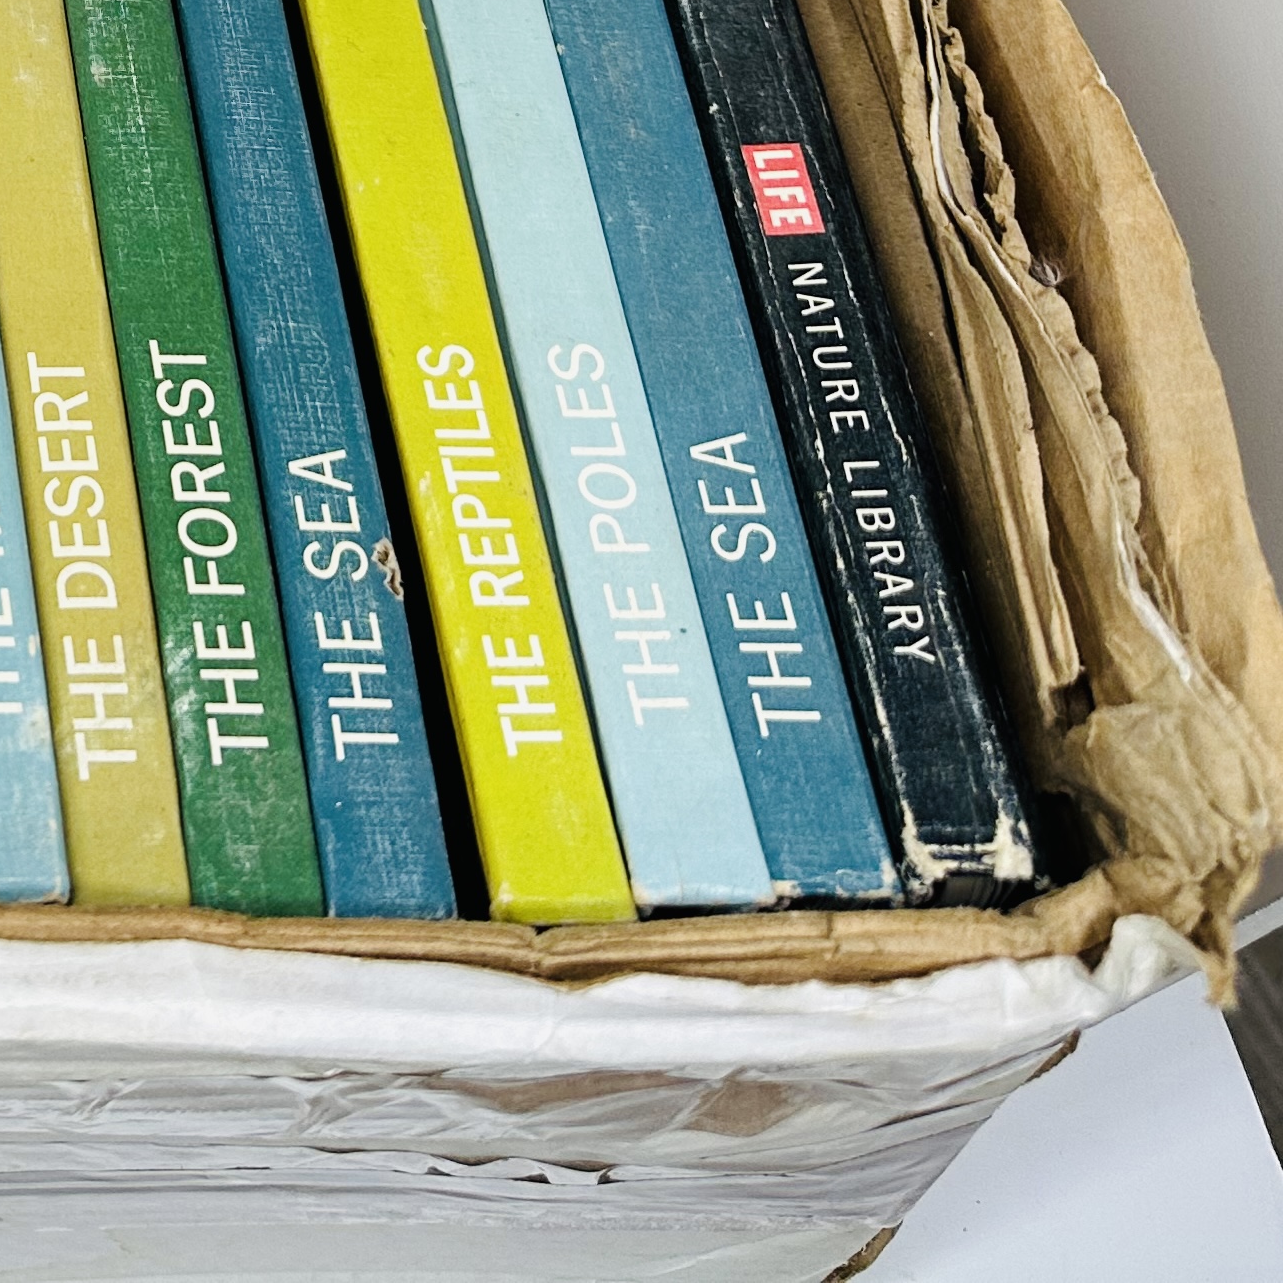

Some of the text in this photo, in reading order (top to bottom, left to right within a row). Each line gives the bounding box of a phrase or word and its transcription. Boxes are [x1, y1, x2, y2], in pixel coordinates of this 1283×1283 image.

[27, 351, 136, 780] THE DESERT
[149, 339, 269, 765] THE FOREST
[287, 449, 399, 760] THE SEA
[416, 344, 563, 756] THE REPTILES
[547, 342, 689, 726] THE POLES
[689, 432, 821, 737] THE SEA
[753, 149, 935, 663] LIFE NATURE LIBRARY
